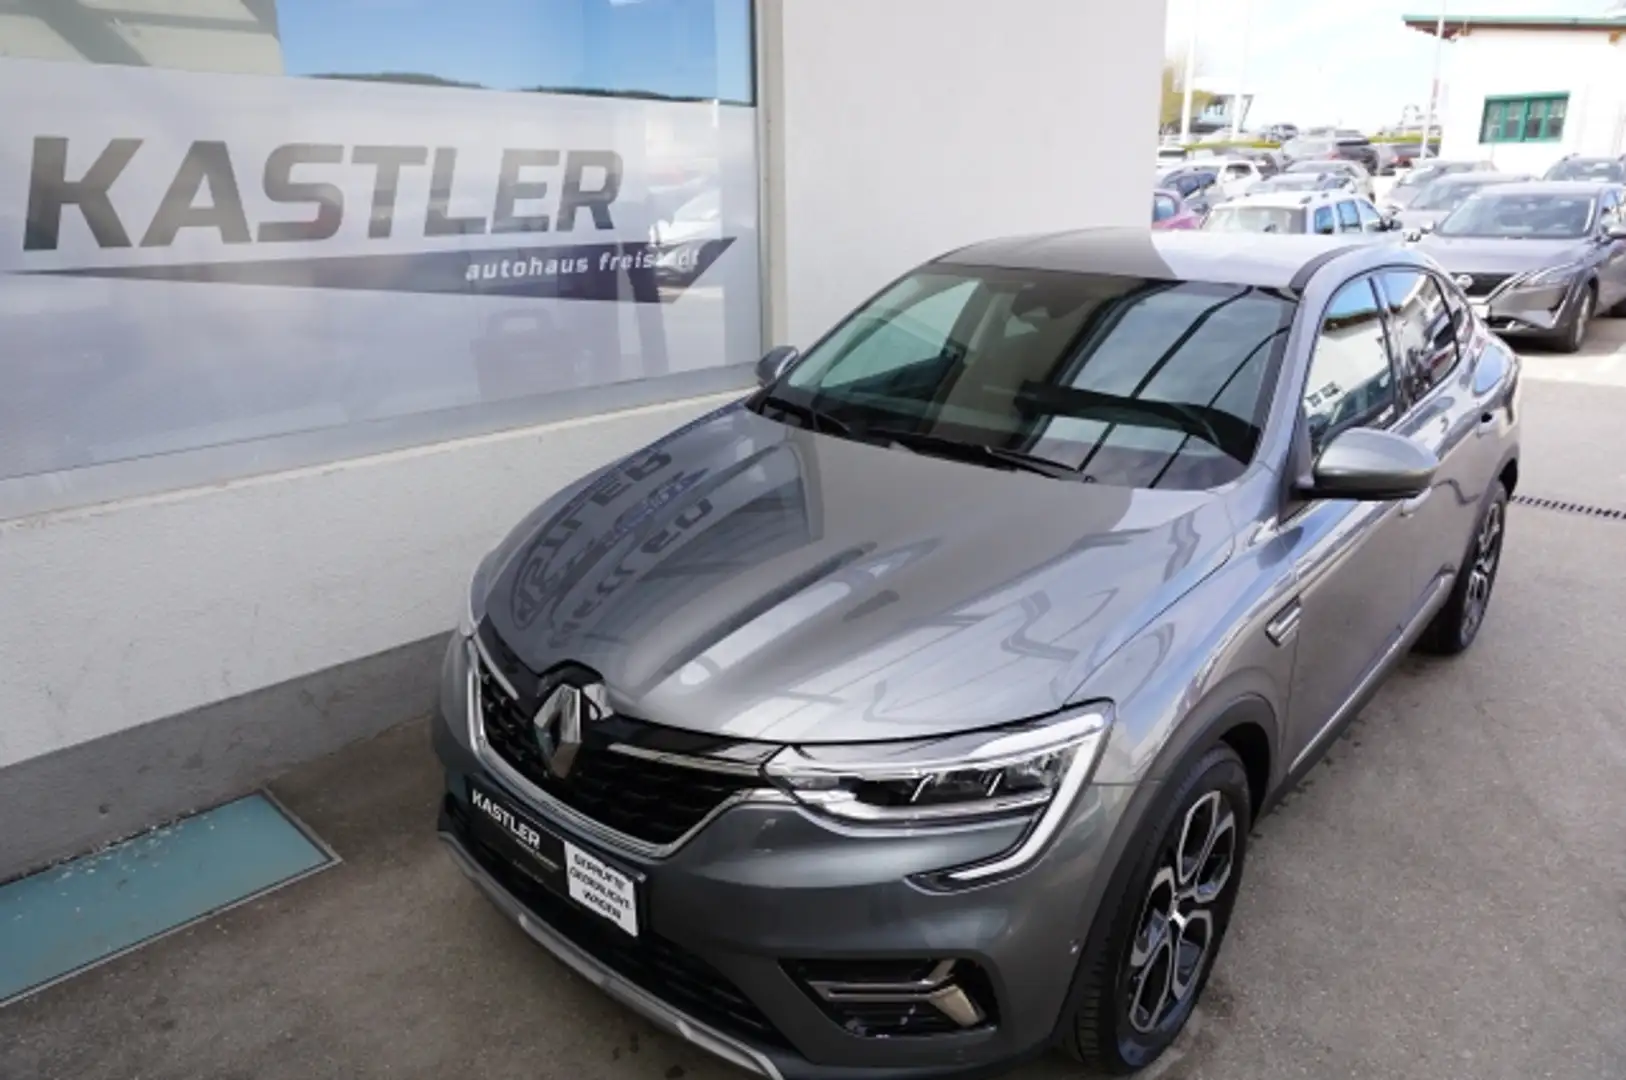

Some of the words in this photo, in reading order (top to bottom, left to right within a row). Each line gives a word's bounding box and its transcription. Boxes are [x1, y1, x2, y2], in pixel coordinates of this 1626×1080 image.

[22, 136, 624, 251] KASTLER
[465, 256, 588, 281] autohaus
[599, 248, 700, 271] freisdt
[472, 788, 540, 849] KASTLER
